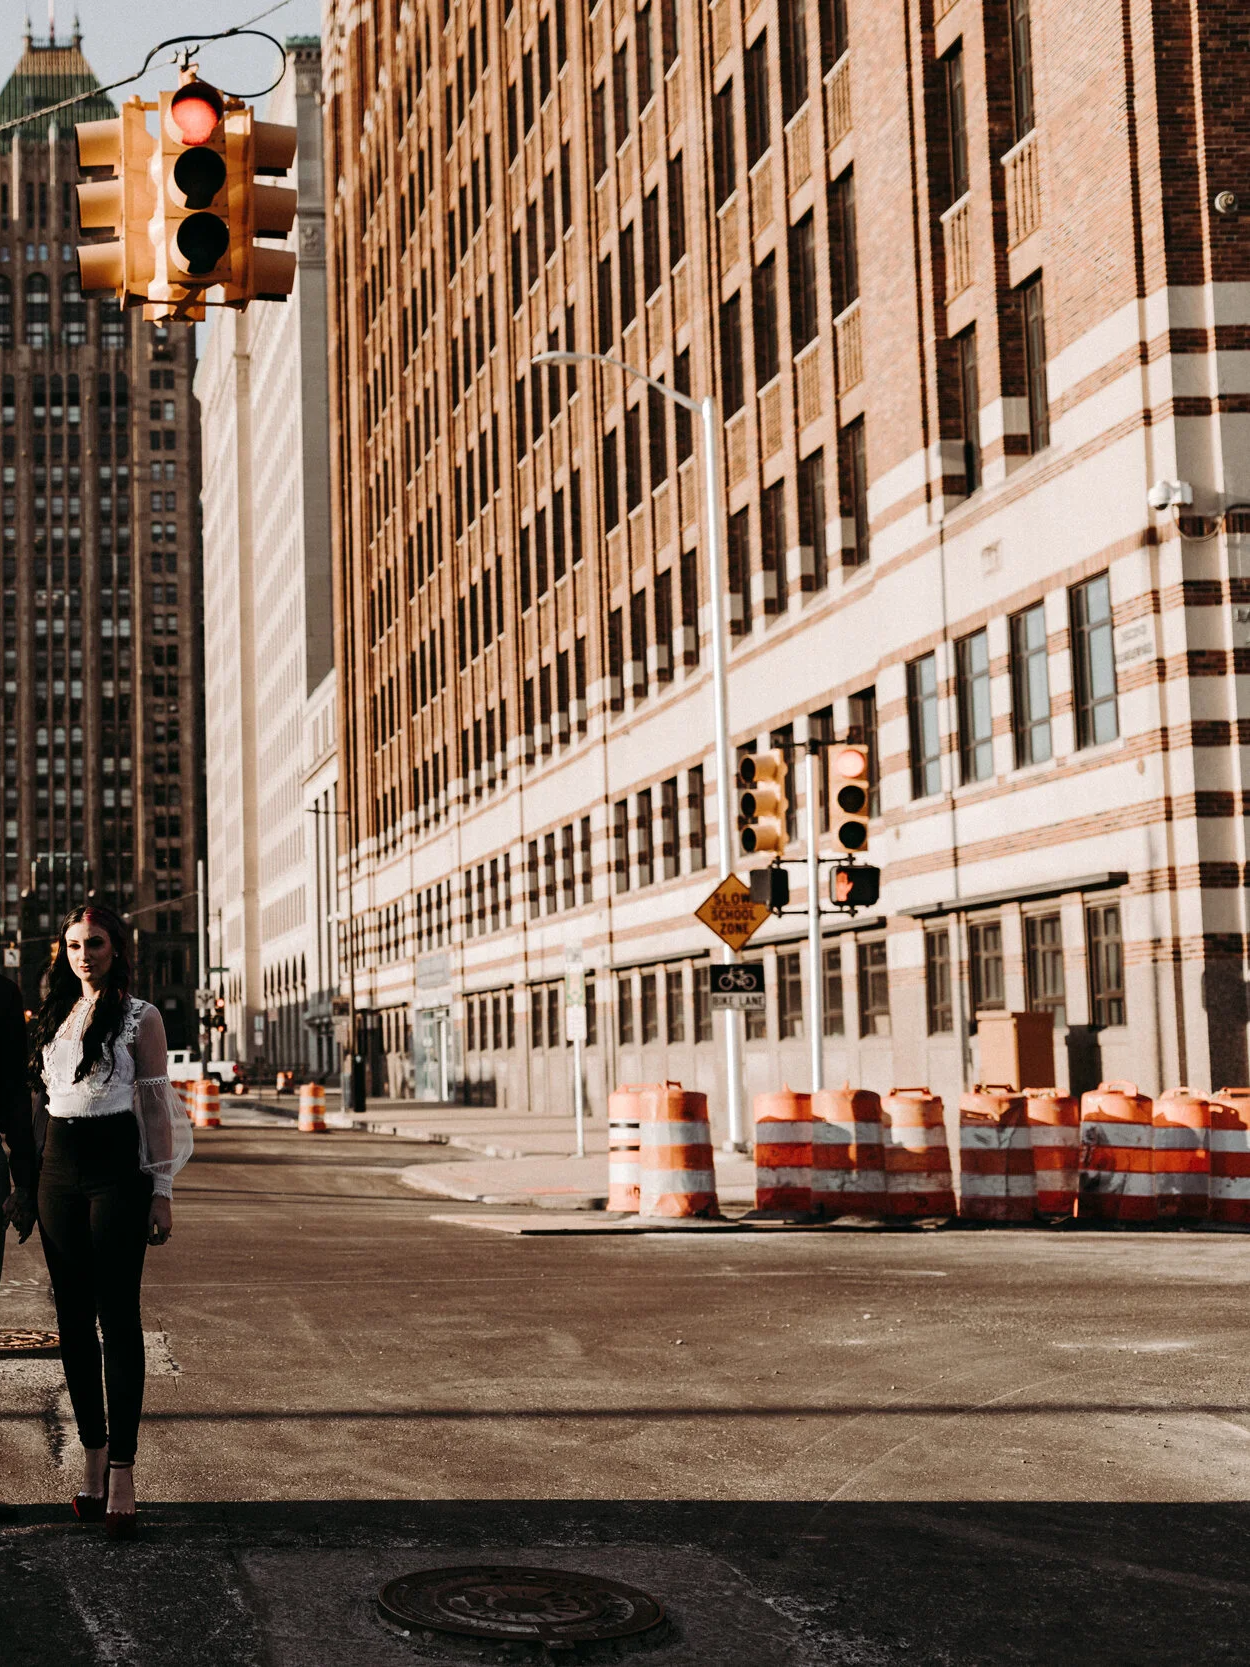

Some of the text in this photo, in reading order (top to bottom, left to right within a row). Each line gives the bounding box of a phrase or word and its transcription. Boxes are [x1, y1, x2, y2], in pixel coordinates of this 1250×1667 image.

[713, 893, 751, 906] SLOW
[711, 909, 756, 921] SCHOOL
[720, 923, 749, 935] ZONE
[712, 995, 763, 1006] BIKE LANE
